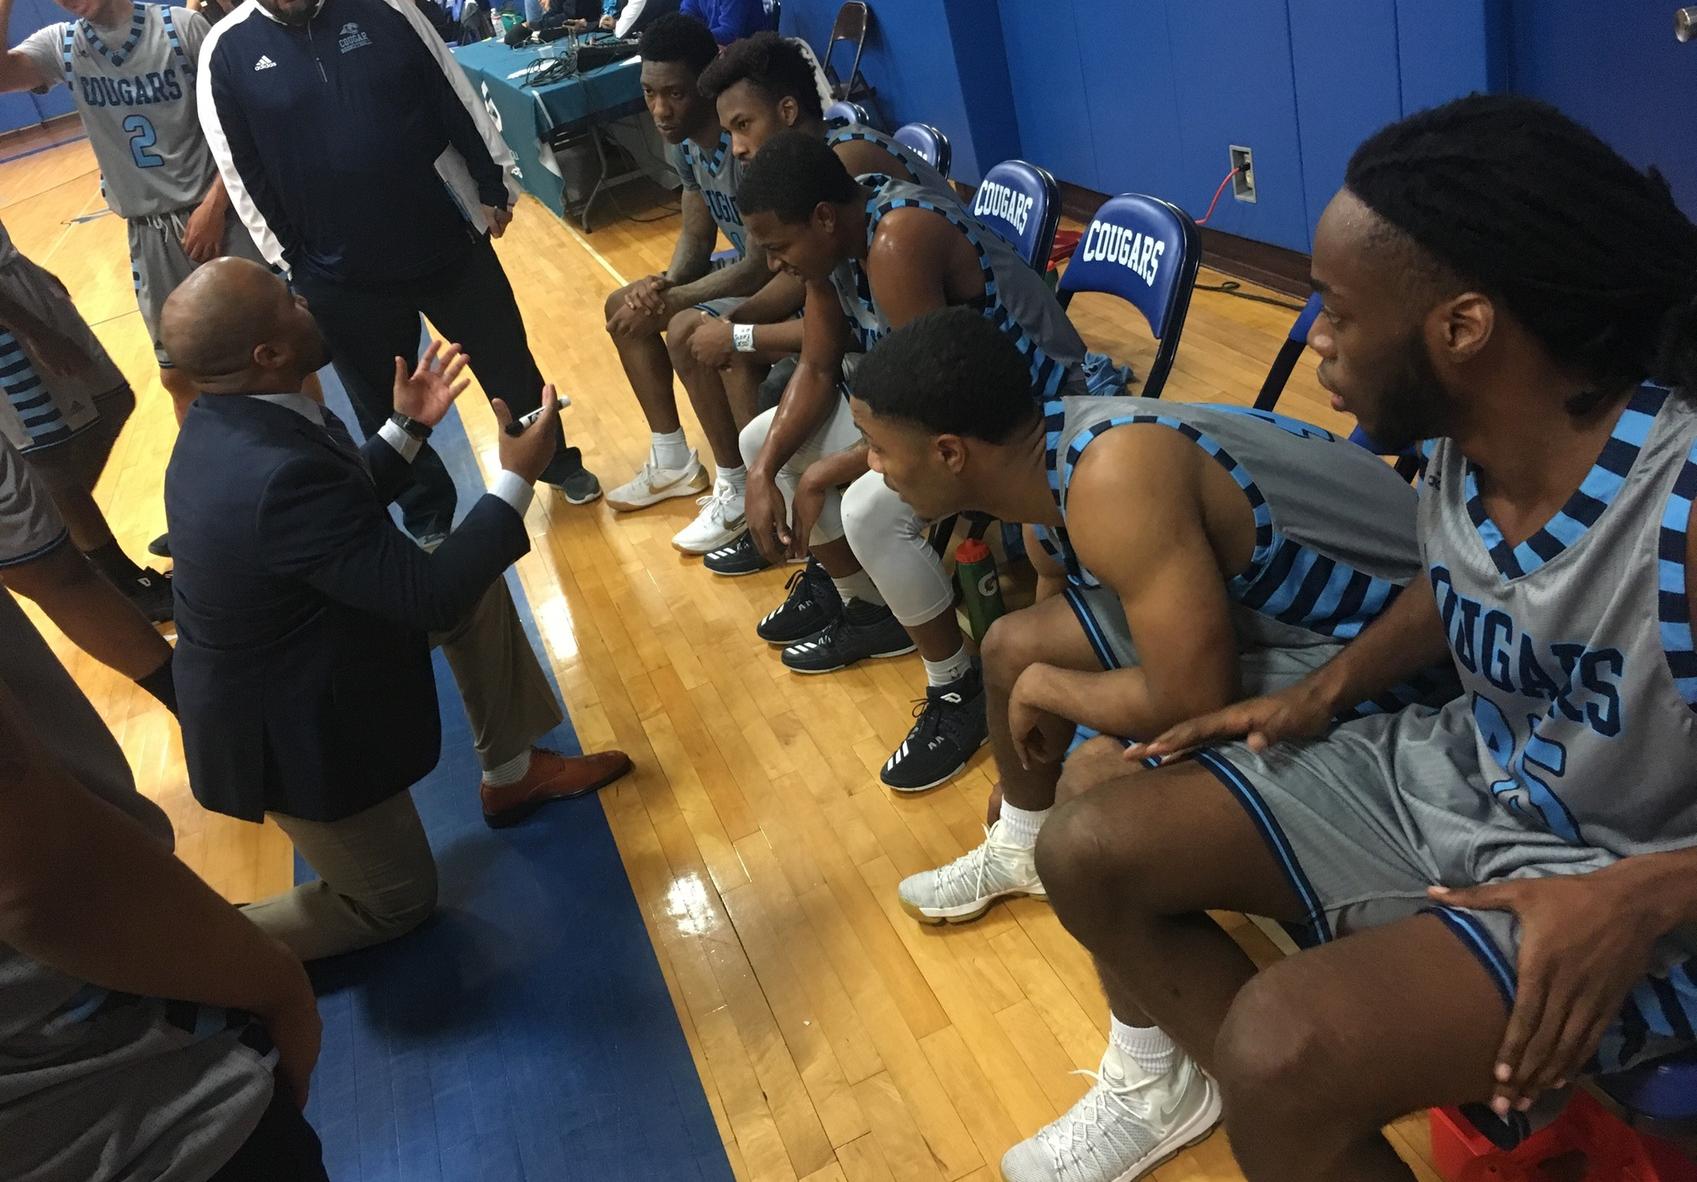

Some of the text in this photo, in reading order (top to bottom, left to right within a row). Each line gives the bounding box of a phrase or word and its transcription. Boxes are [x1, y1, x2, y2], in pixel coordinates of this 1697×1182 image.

[79, 68, 183, 107] COUGARS
[122, 114, 165, 168] 2
[974, 179, 1034, 236] COUGARS
[1083, 219, 1165, 287] COUGARS
